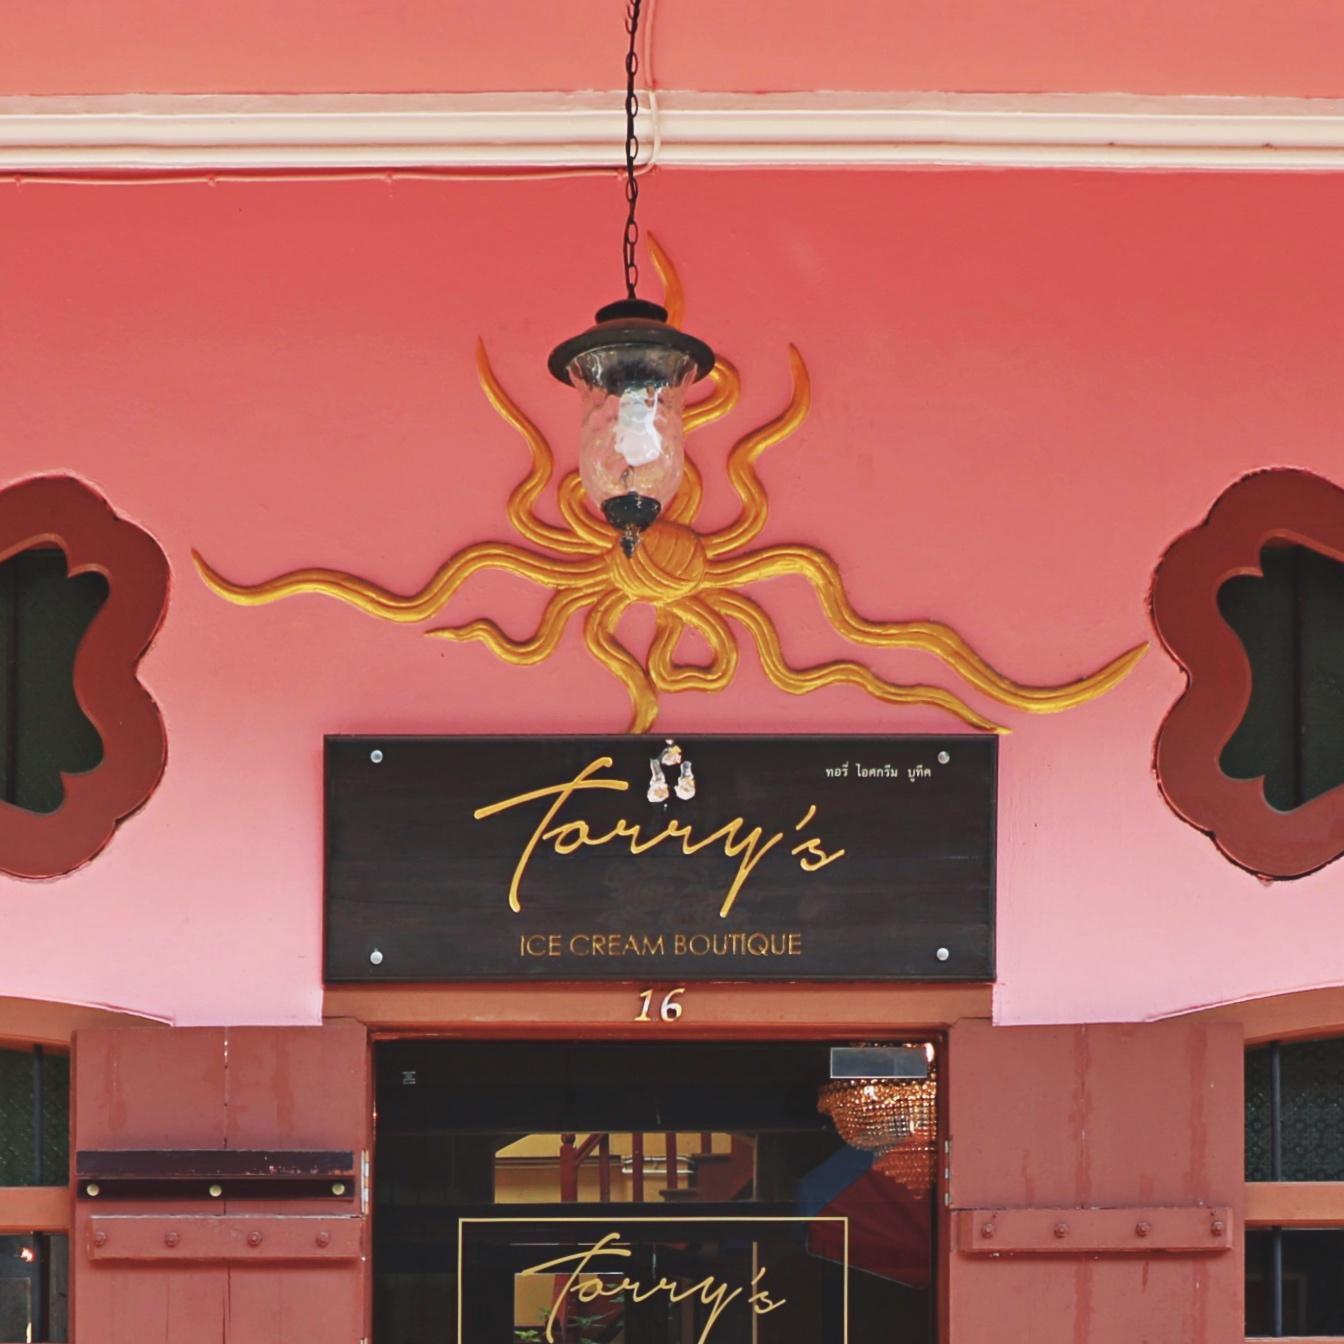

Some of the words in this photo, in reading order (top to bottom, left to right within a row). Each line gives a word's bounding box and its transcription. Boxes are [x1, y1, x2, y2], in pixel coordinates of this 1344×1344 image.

[856, 763, 898, 778] ไอศกรีม
[519, 935, 561, 956] ICE
[569, 934, 665, 956] CREAM
[674, 932, 802, 956] BOUTIQUE
[634, 987, 686, 1022] 16
